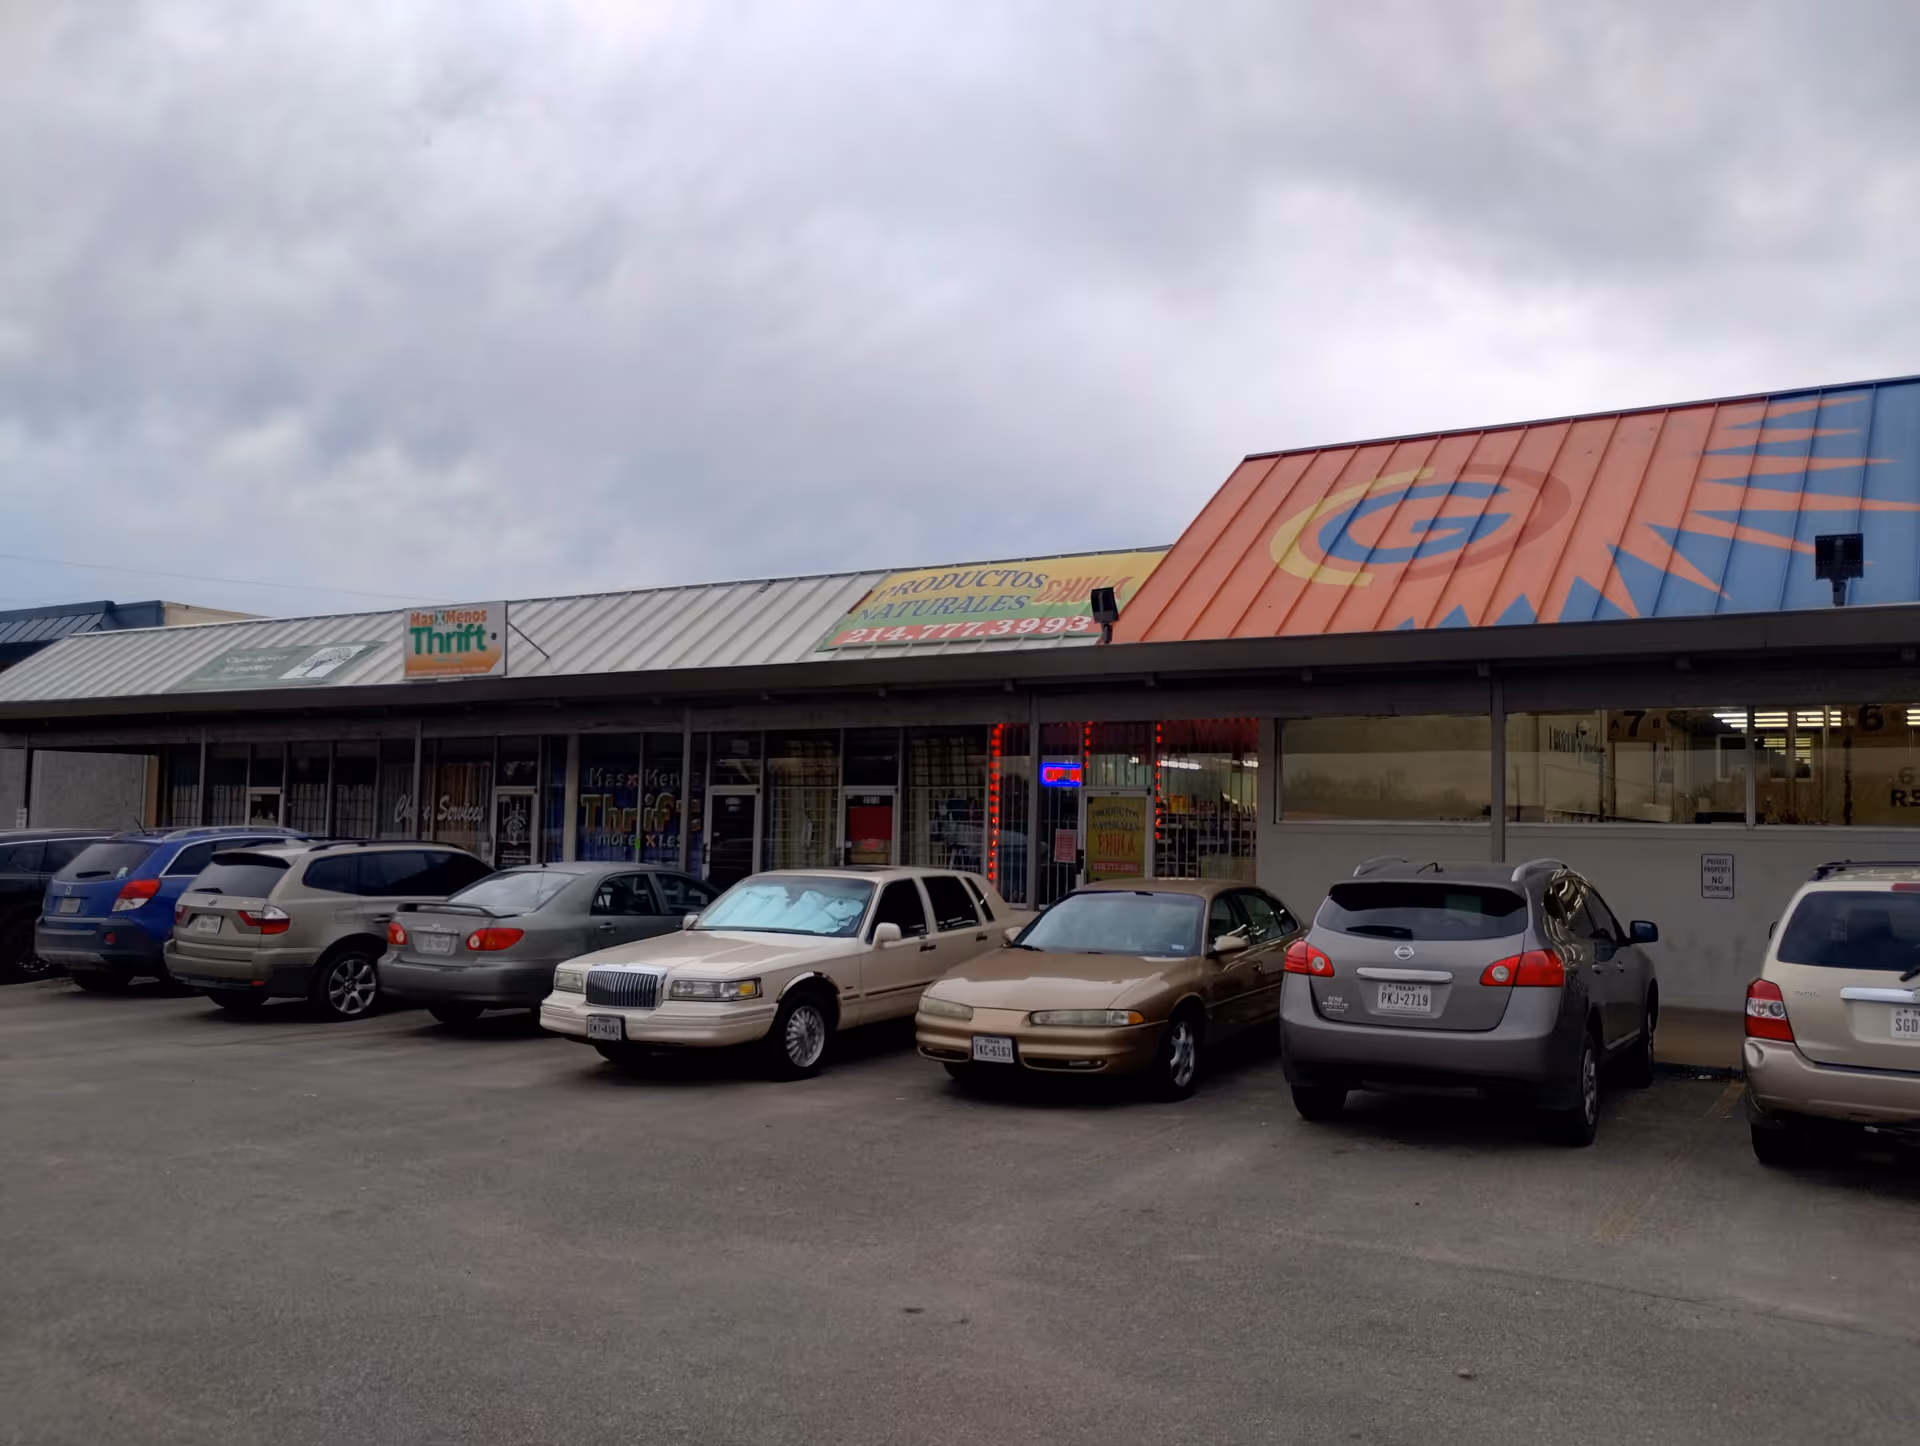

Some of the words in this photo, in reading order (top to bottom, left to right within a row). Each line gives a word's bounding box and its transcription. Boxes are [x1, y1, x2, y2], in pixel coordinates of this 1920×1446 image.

[873, 569, 1049, 602] PRODUCTOS
[445, 609, 488, 624] Menos
[862, 594, 1031, 620] NATURALES
[410, 623, 488, 655] Thrift
[843, 615, 1092, 644] 214.777.3993
[1623, 709, 1647, 738] 7
[1858, 704, 1885, 732] 6
[1711, 876, 1724, 885] NO
